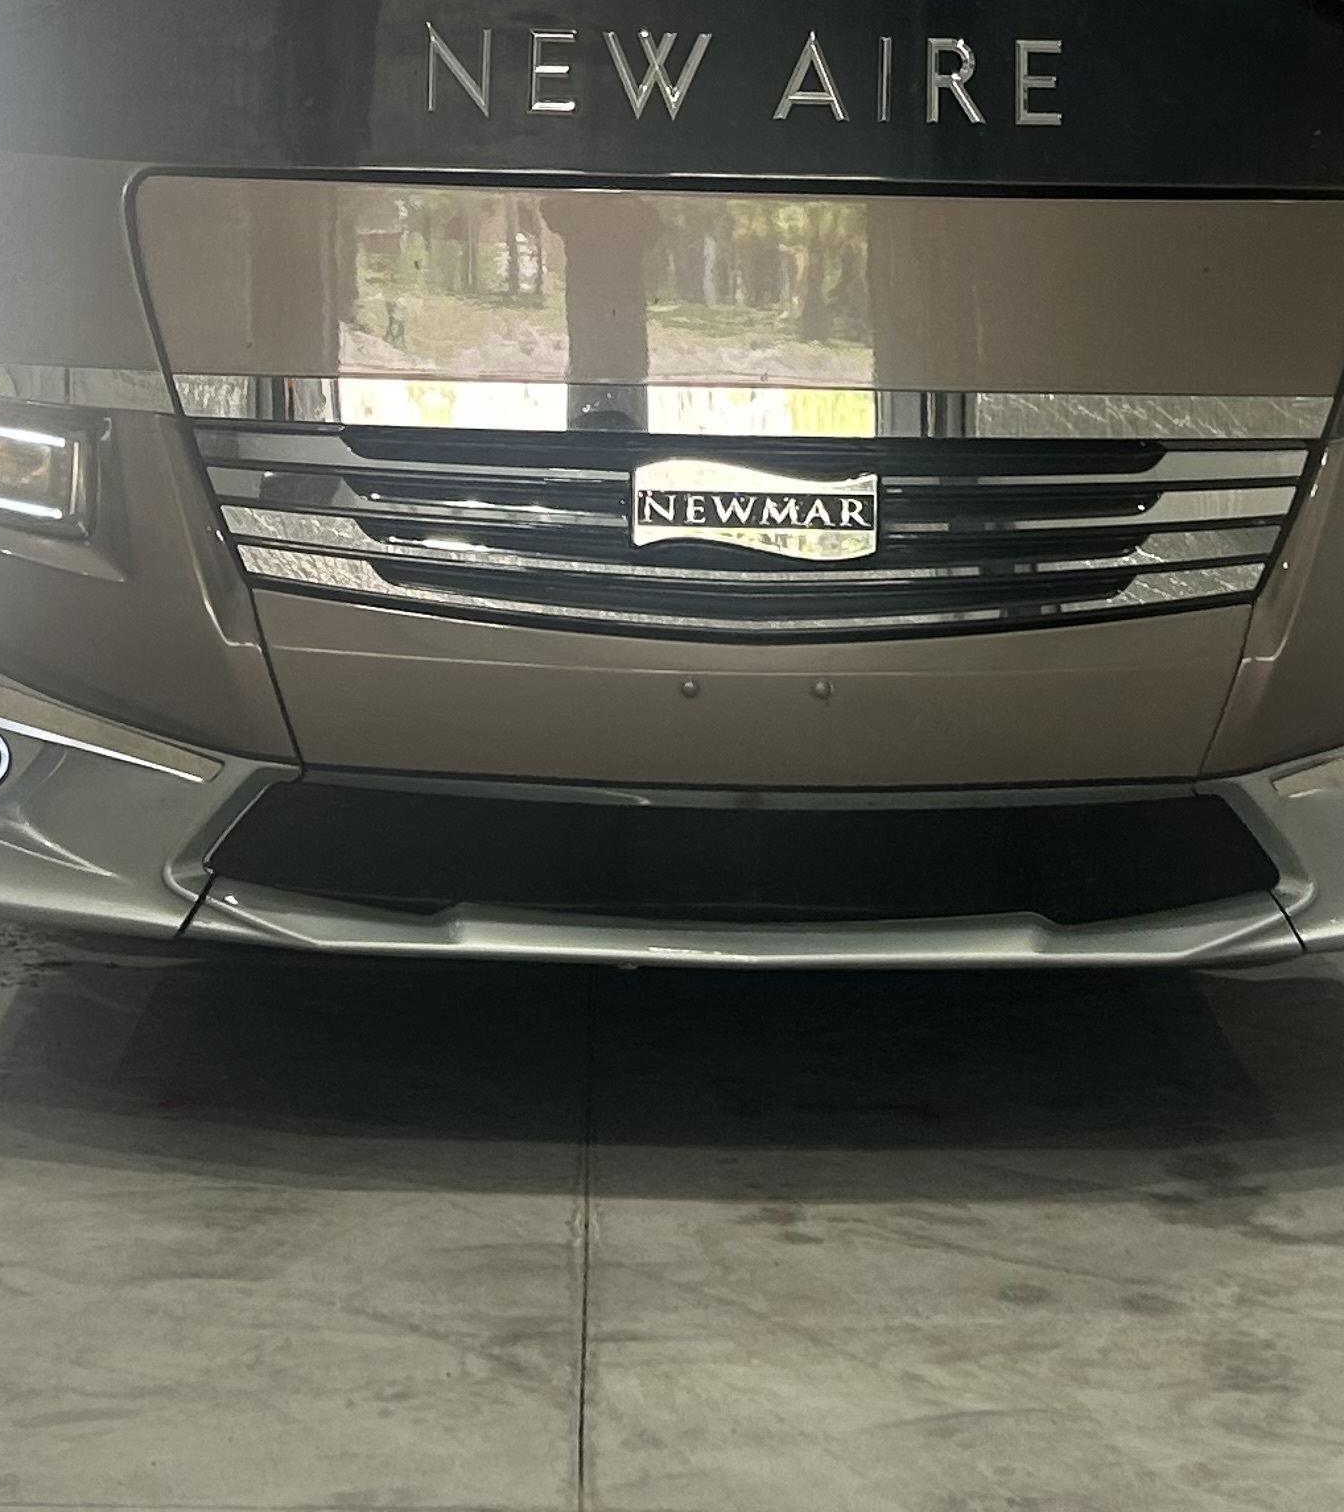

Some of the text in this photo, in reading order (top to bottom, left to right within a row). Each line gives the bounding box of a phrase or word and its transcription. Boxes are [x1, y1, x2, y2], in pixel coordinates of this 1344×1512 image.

[425, 21, 1064, 126] NEW AIRE
[638, 489, 872, 528] NEWMAR
